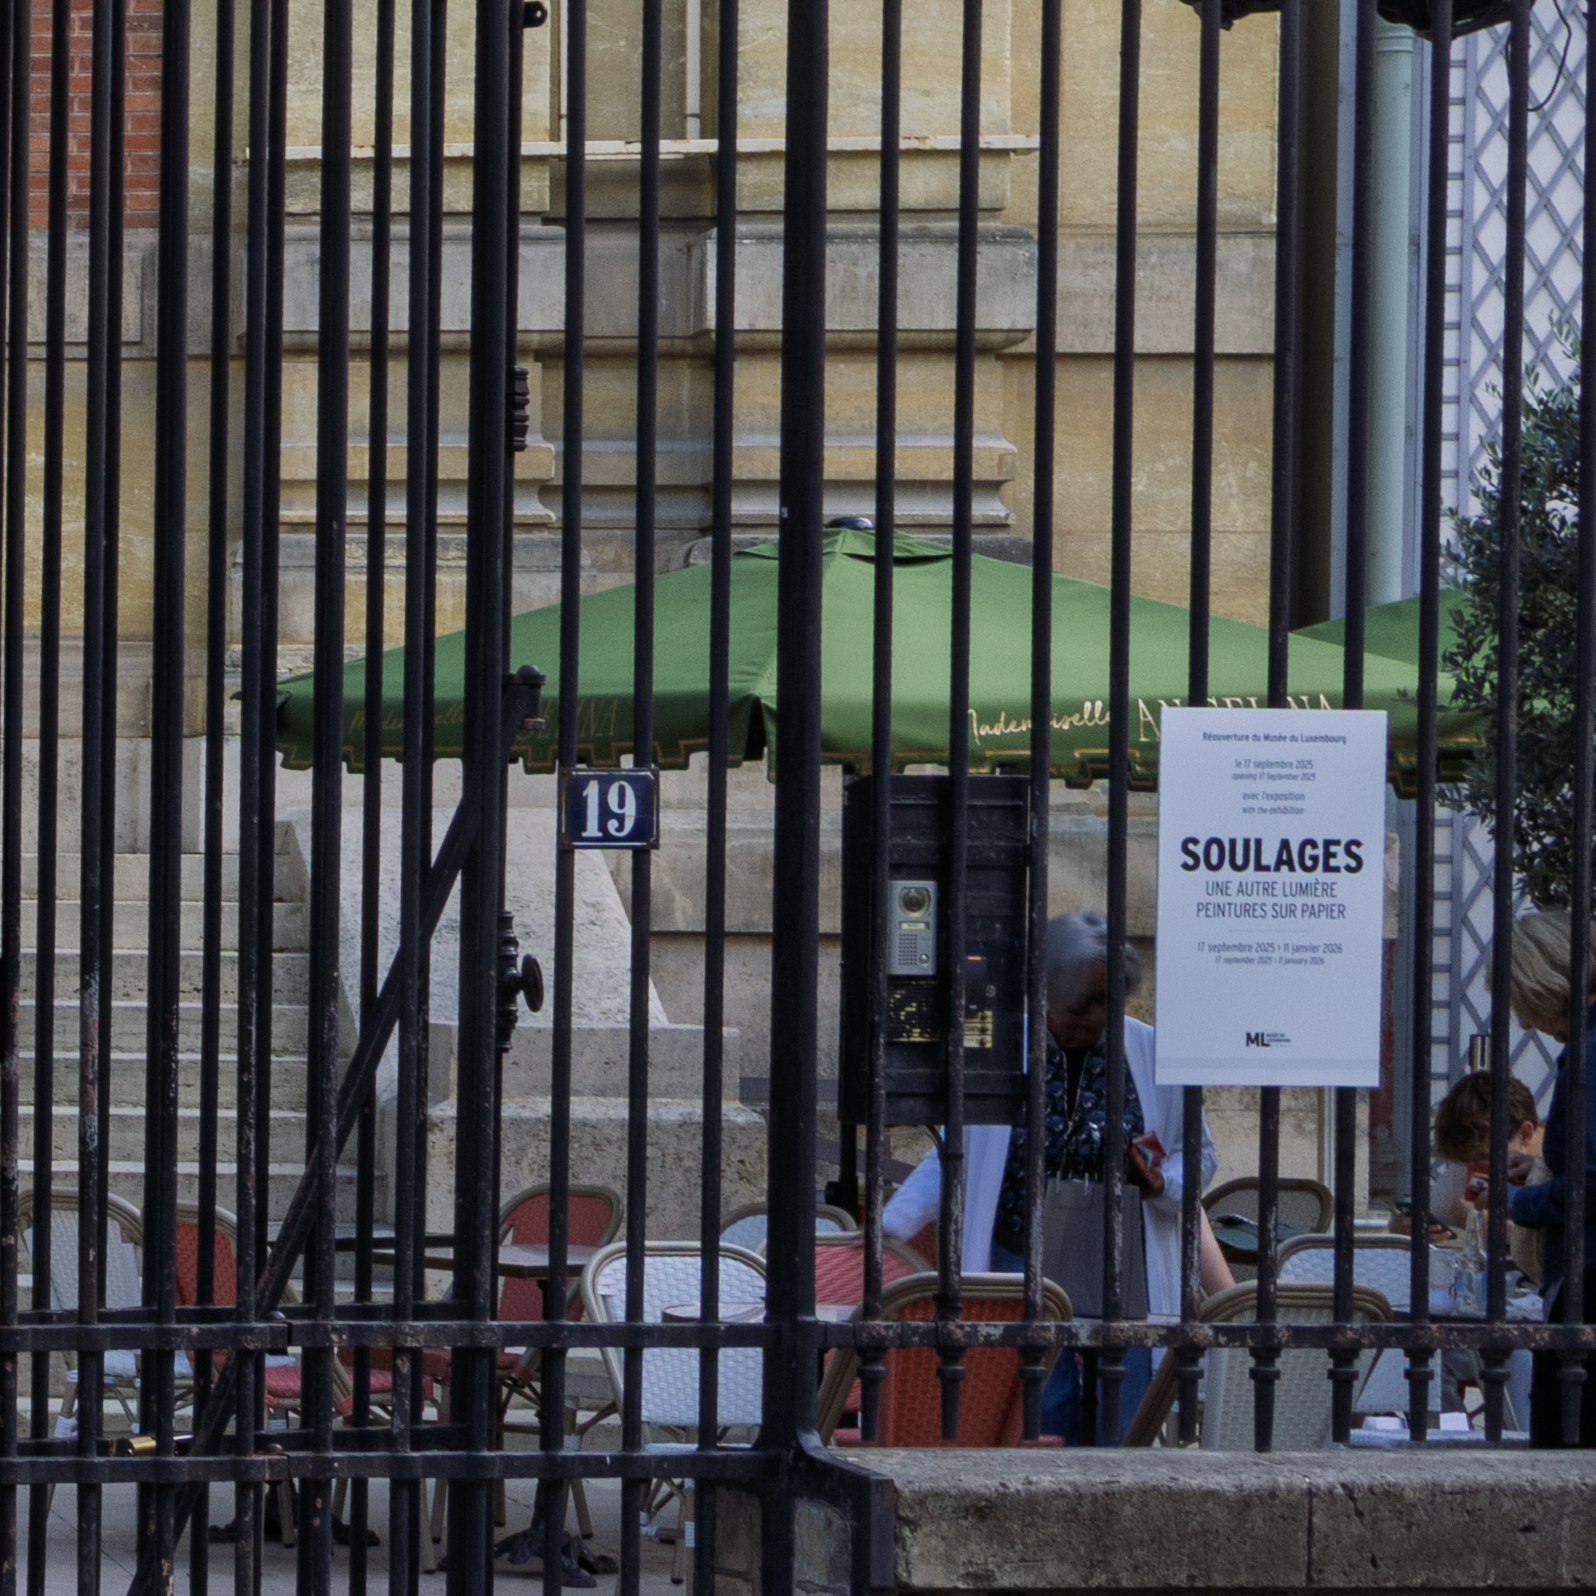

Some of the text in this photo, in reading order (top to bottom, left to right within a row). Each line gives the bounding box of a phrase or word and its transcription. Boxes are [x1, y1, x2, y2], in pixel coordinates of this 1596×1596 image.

[1202, 732, 1346, 745] Réouverture du Musée du Luxembourg
[1235, 759, 1314, 770] le 17 septembre 2025
[1242, 793, 1259, 801] avec
[581, 780, 637, 838] 19
[1180, 836, 1364, 874] SOULAGES
[1205, 878, 1337, 898] UNE AUTRE LUMIÈRE
[1196, 902, 1346, 919] PEINTURES SUR PAPIER
[1197, 942, 1205, 952] 17
[1208, 942, 1253, 954] septembre
[1255, 942, 1275, 953] 2025
[1291, 943, 1320, 955] janvier
[1322, 943, 1343, 954] 2026
[1246, 1032, 1270, 1047] ML
